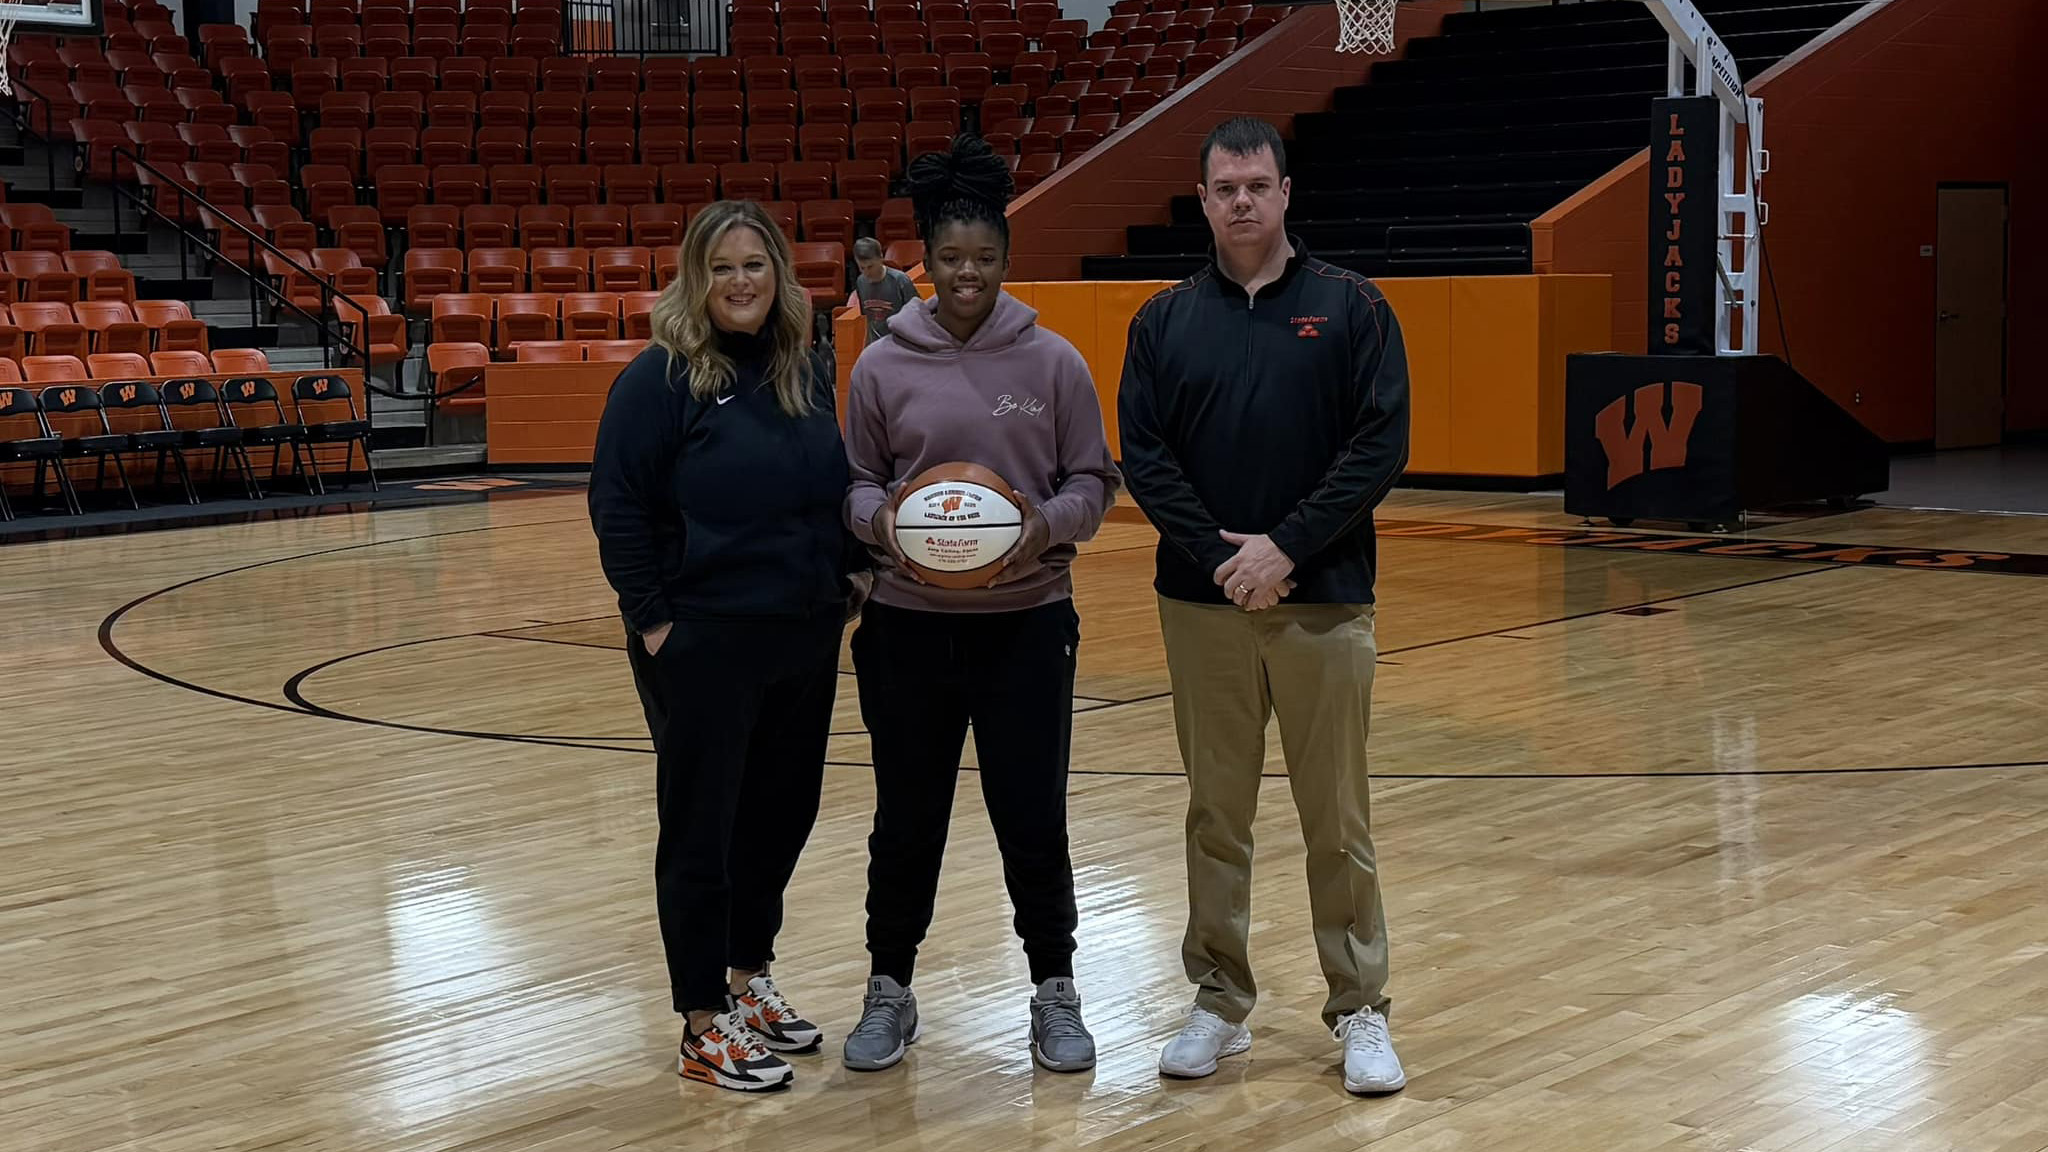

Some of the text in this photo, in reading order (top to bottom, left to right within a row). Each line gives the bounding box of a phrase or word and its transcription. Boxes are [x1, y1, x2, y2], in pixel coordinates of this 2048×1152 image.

[1711, 55, 1743, 98] MPETITION
[1664, 114, 1686, 344] LADYJACKS
[120, 385, 135, 402] W
[180, 382, 195, 399] W
[241, 381, 256, 397] W
[312, 379, 328, 394] W
[60, 389, 76, 406] W
[1595, 381, 1703, 491] W
